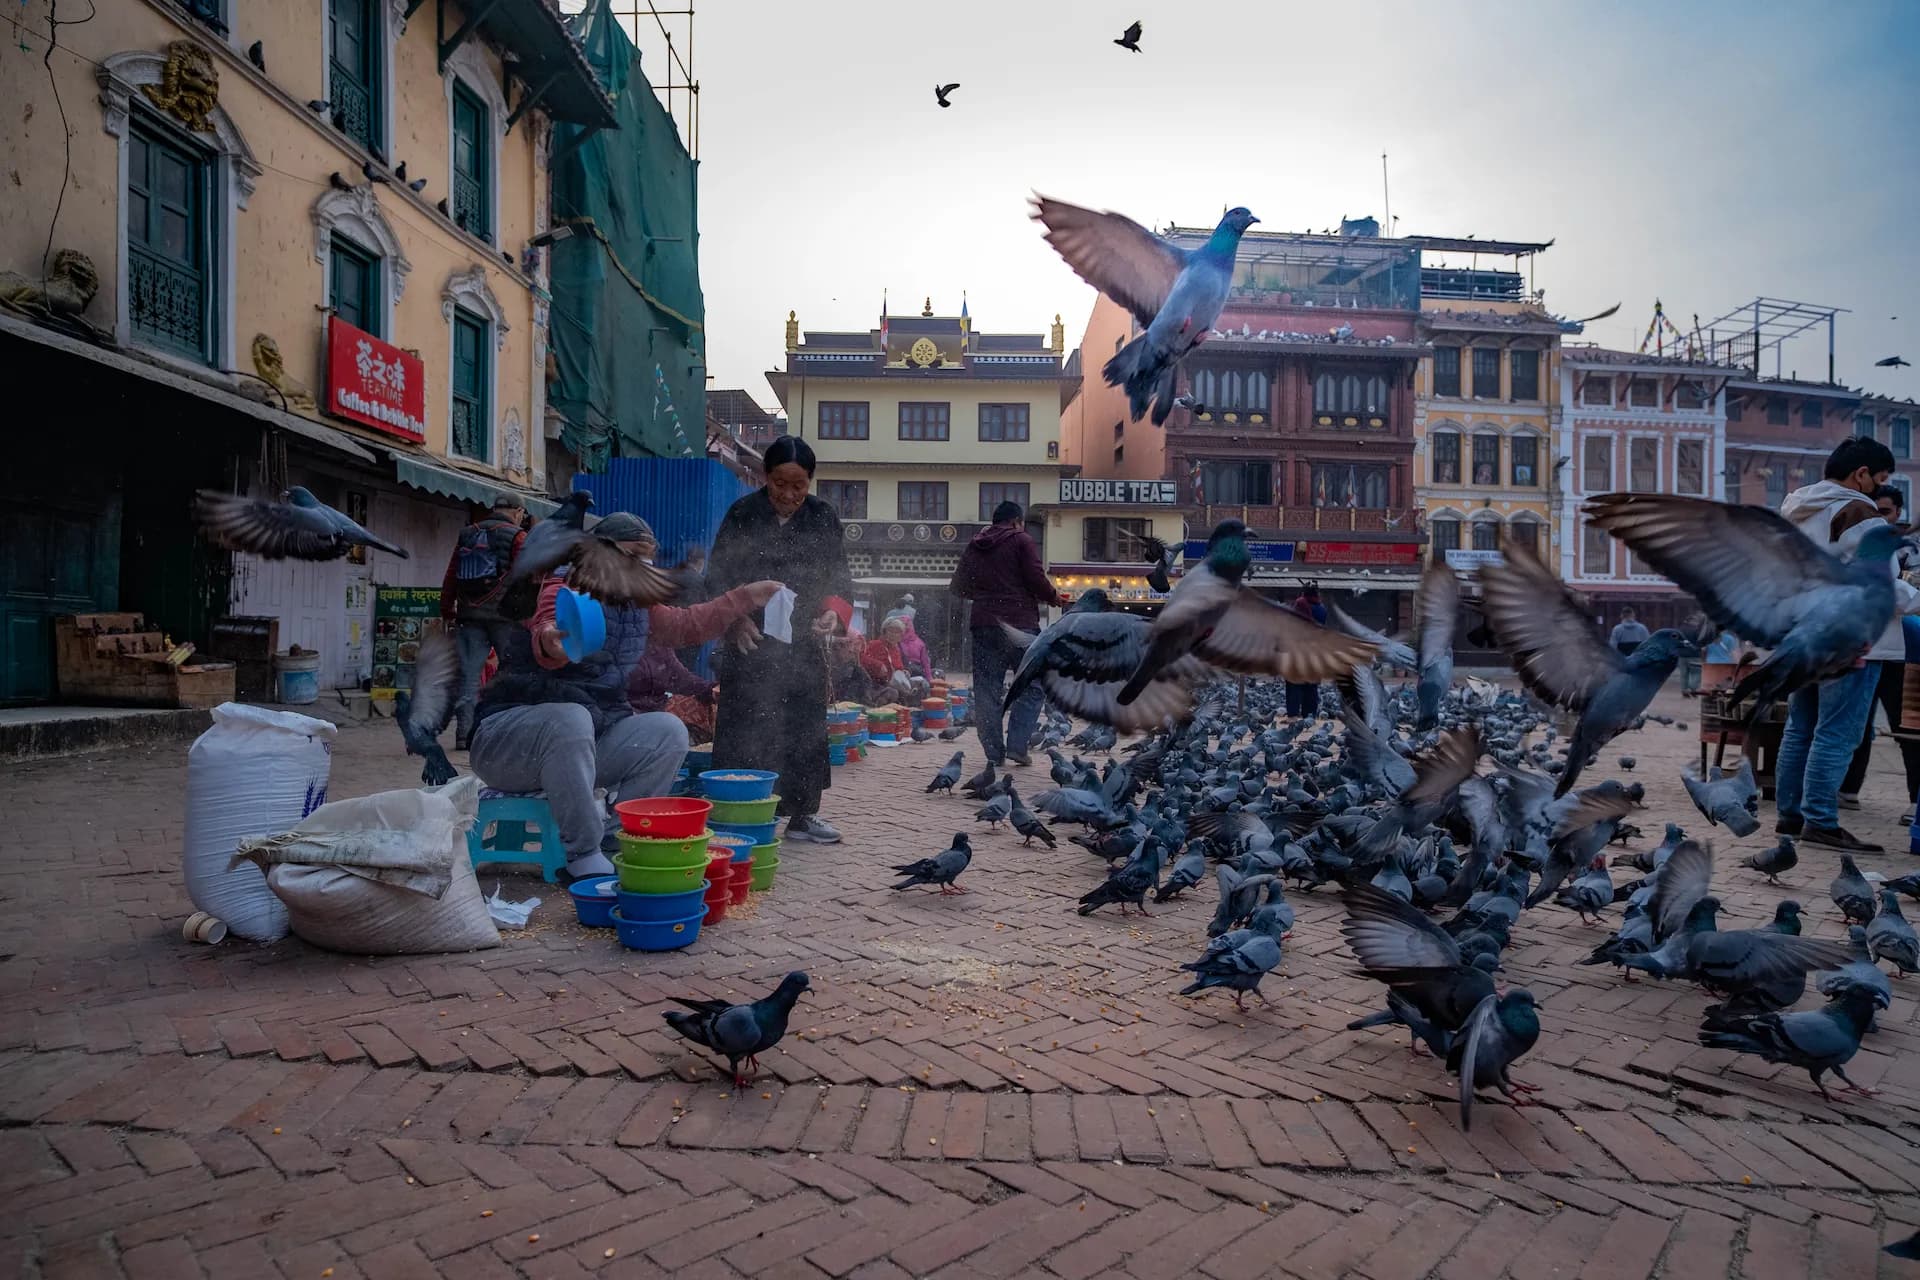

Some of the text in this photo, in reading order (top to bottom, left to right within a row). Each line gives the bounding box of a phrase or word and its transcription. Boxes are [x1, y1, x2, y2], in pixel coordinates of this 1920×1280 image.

[356, 338, 405, 391] 茶之味
[1061, 480, 1161, 502] BUBBLE TEA
